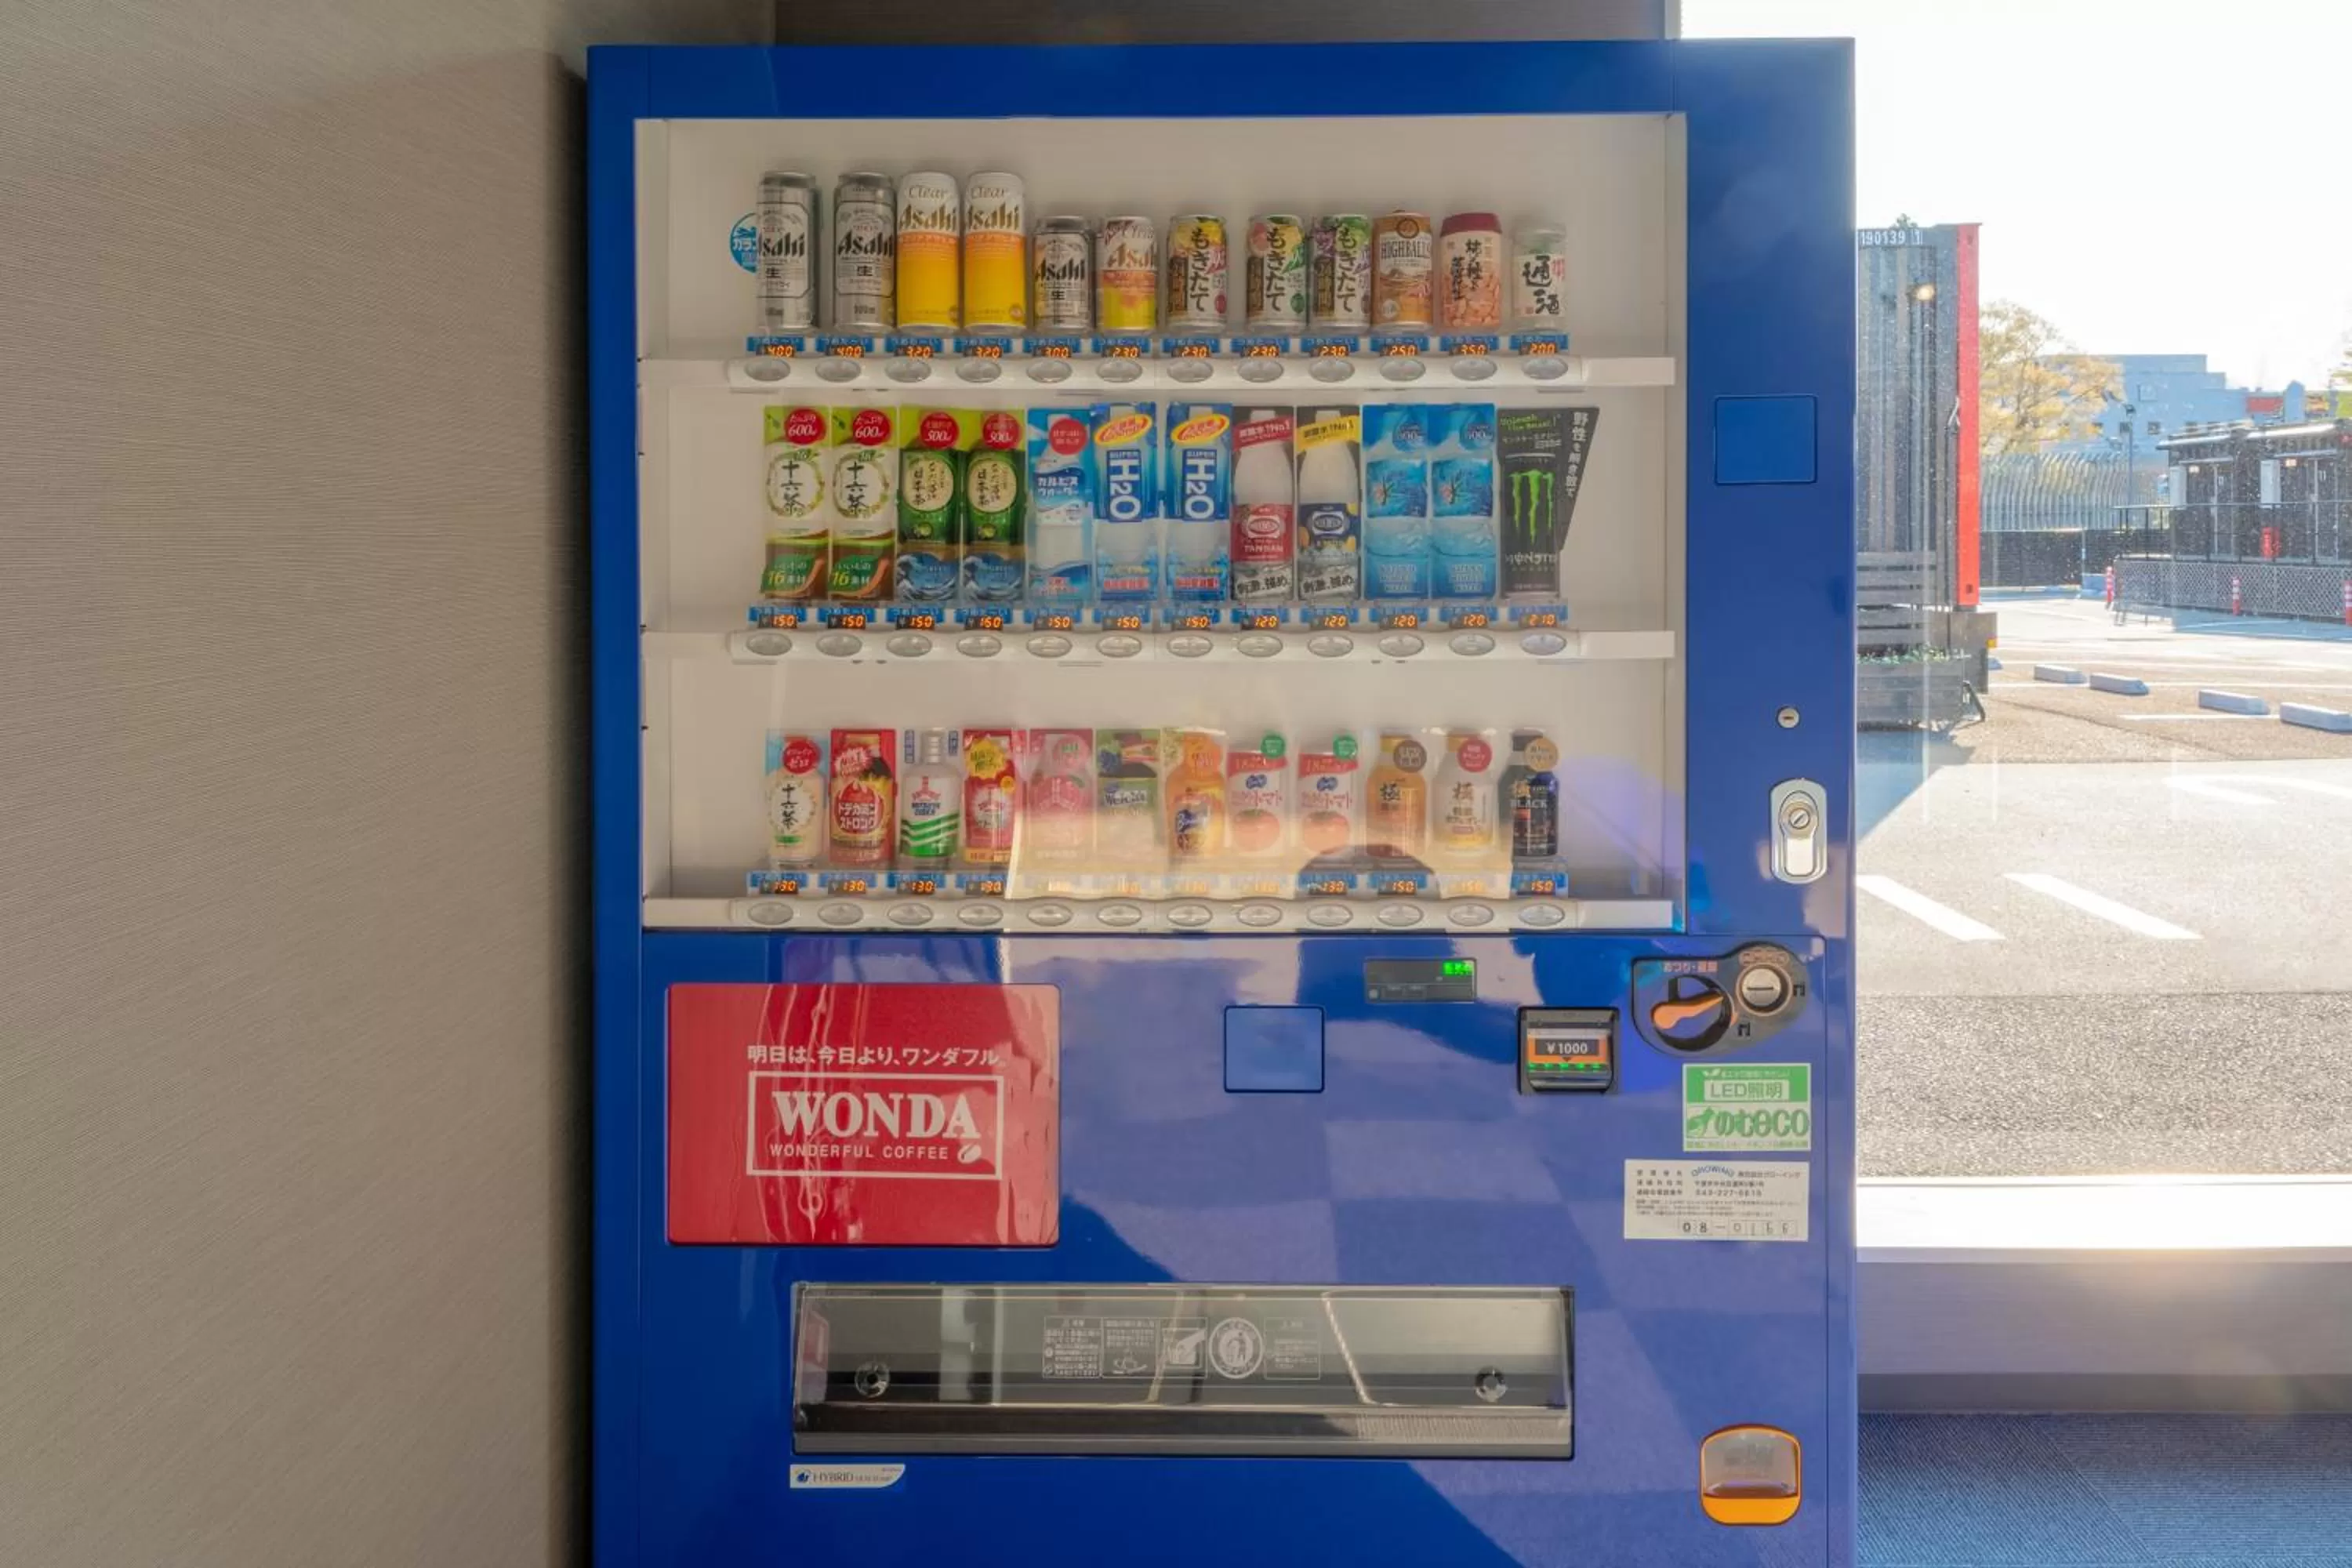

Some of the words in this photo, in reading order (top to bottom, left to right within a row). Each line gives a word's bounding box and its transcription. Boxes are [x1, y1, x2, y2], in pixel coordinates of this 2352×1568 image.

[899, 204, 957, 231] Asahi
[965, 202, 1020, 231] Asahi
[837, 230, 894, 258] Asahi
[1861, 230, 1907, 246] 190139
[1035, 257, 1086, 281] Asahi
[1189, 227, 1210, 313] もぎたて
[1266, 226, 1287, 312] もぎたて
[1335, 226, 1356, 313] もぎたて
[781, 460, 807, 514] 十六茶
[845, 461, 873, 514] 十六茶
[781, 784, 799, 830] 十六茶
[1510, 798, 1548, 808] BLACK
[746, 1044, 1007, 1067] 明日は、今日より、ワンダフル。
[1710, 1082, 1783, 1099] LED照明
[771, 1091, 981, 1139] WONDA
[770, 1143, 874, 1159] WONDERFUL
[883, 1145, 949, 1160] COFFEE
